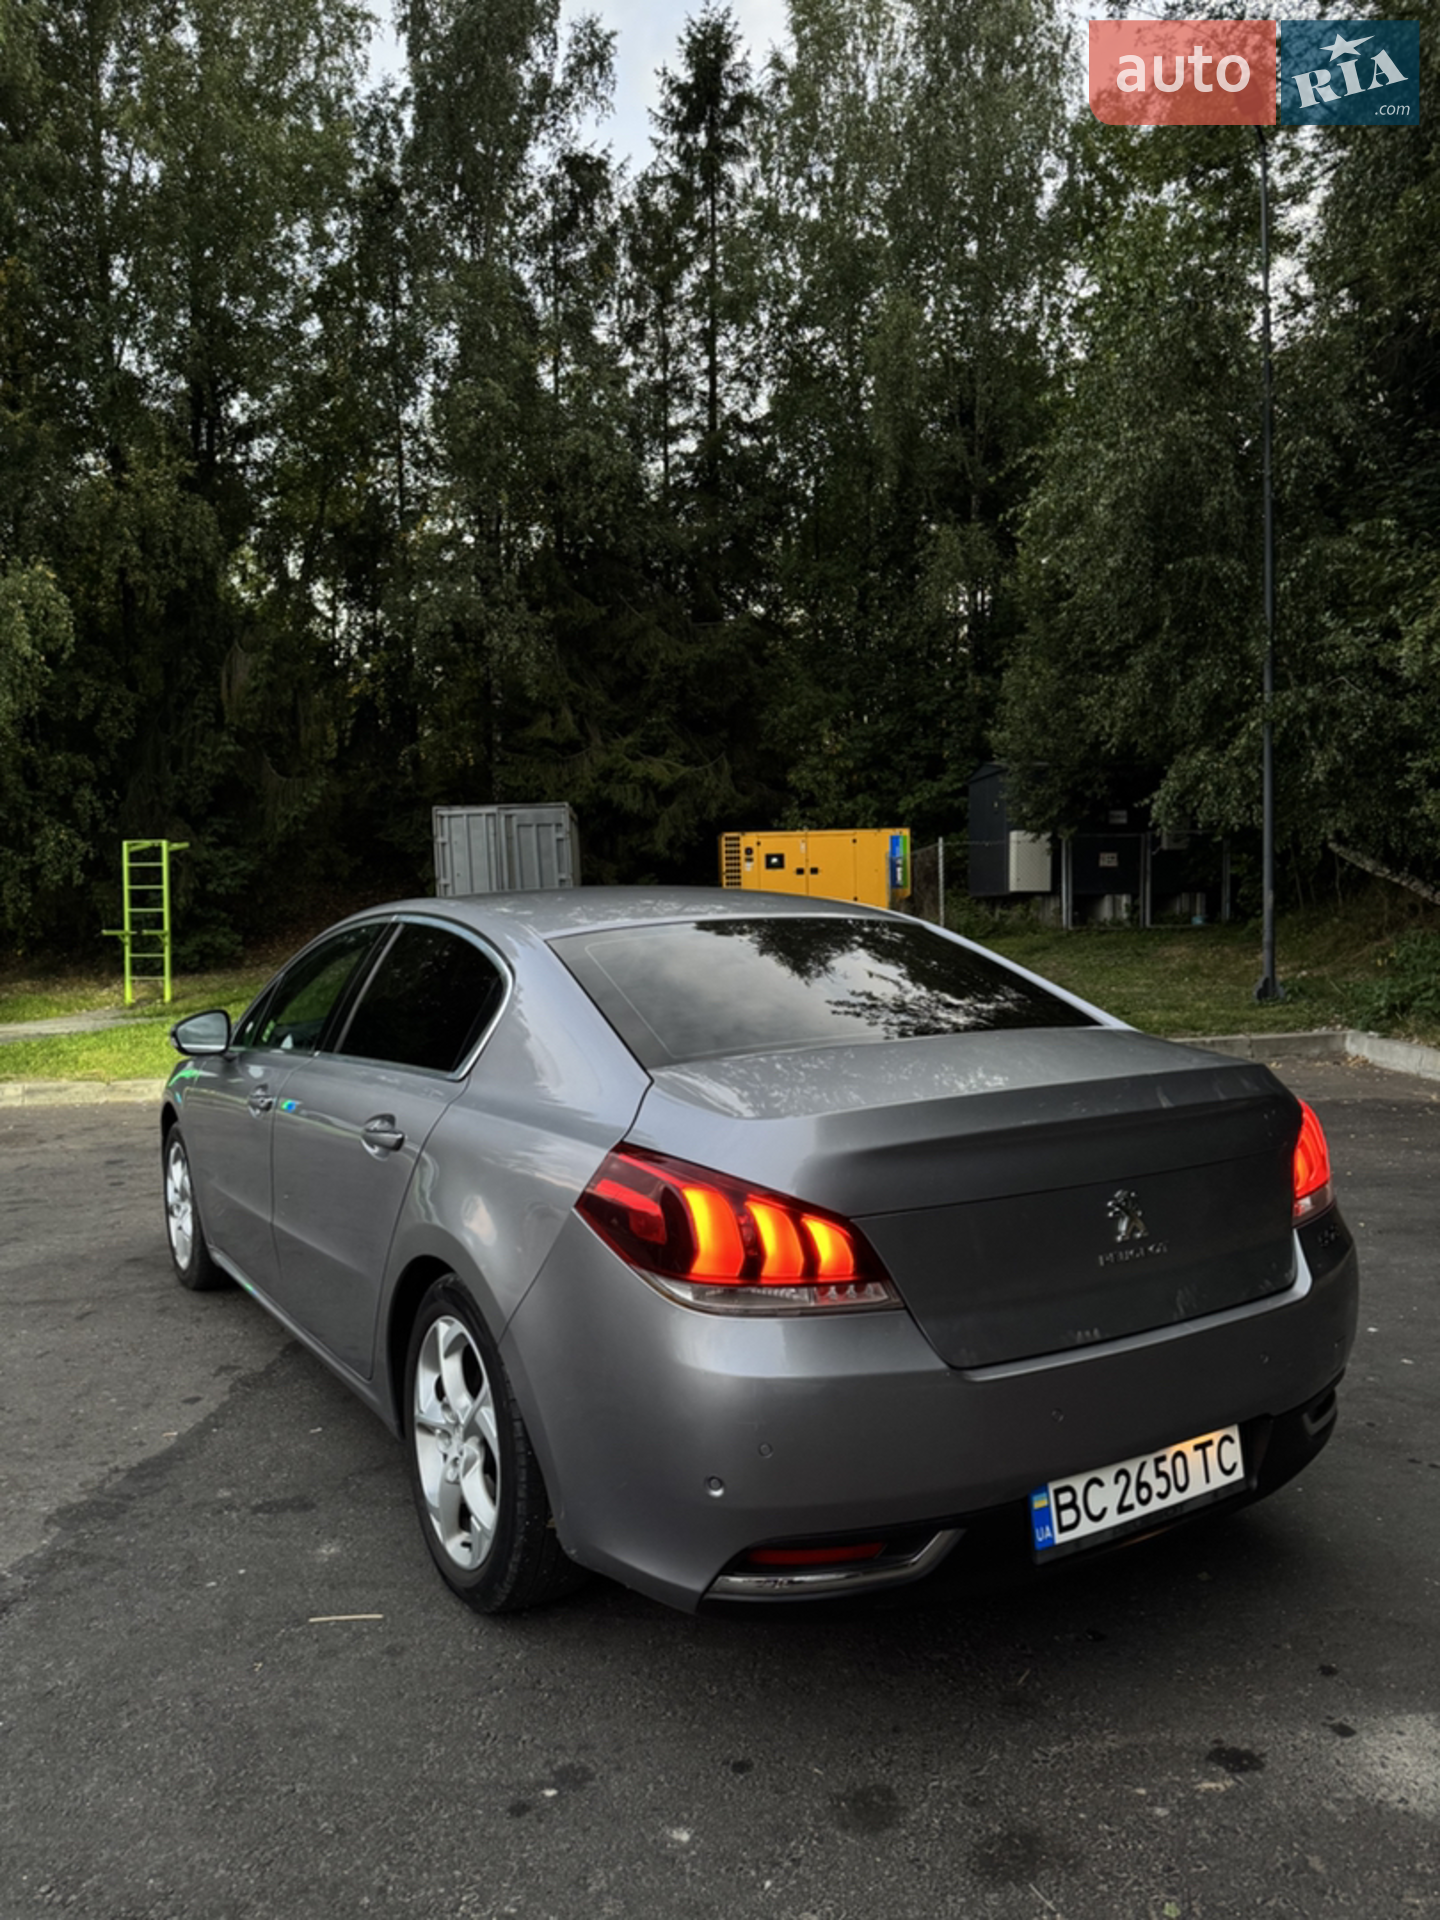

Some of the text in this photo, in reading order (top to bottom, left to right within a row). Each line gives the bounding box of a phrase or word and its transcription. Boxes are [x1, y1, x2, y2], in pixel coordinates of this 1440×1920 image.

[1053, 1477, 1107, 1534] BC
[1114, 1450, 1190, 1515] 2650
[1193, 1434, 1238, 1484] TC
[1036, 1526, 1053, 1541] UA
